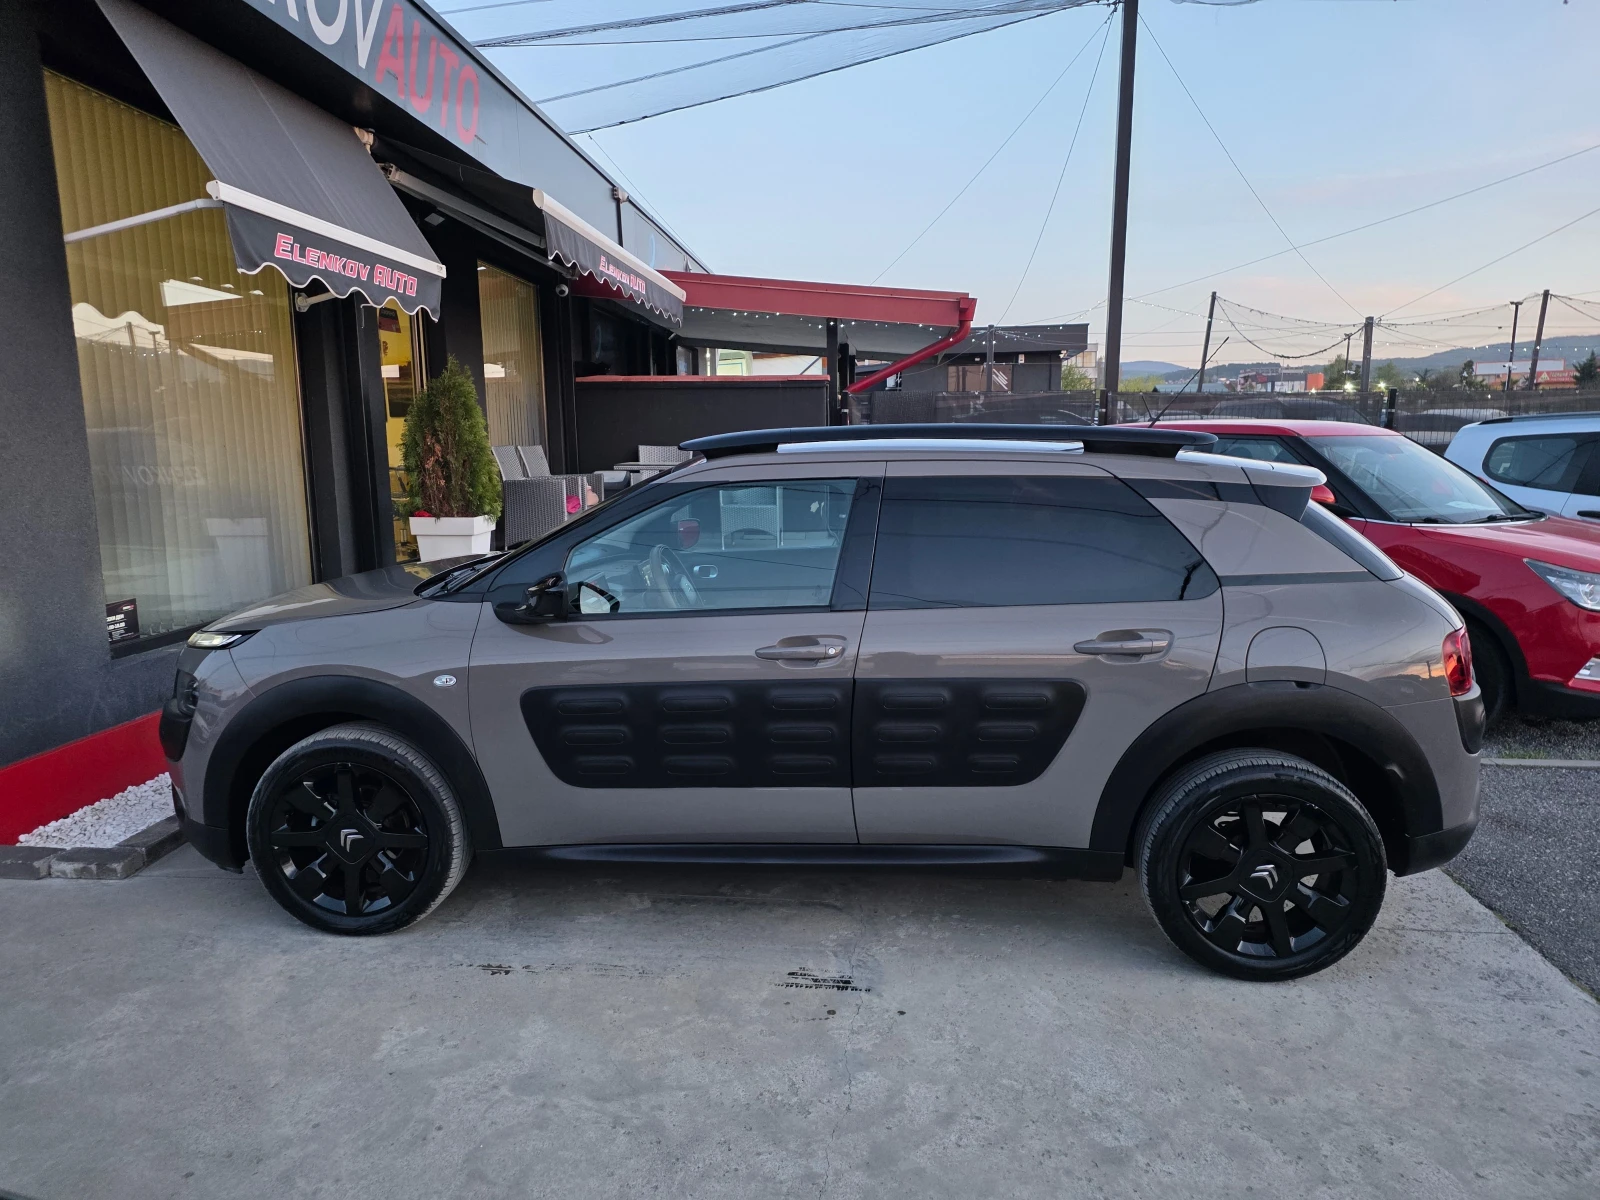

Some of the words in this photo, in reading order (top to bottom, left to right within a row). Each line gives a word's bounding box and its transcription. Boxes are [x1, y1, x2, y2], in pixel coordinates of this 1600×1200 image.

[375, 3, 480, 145] AUTO
[274, 232, 370, 281] ELENKOV
[373, 263, 418, 297] AUTO
